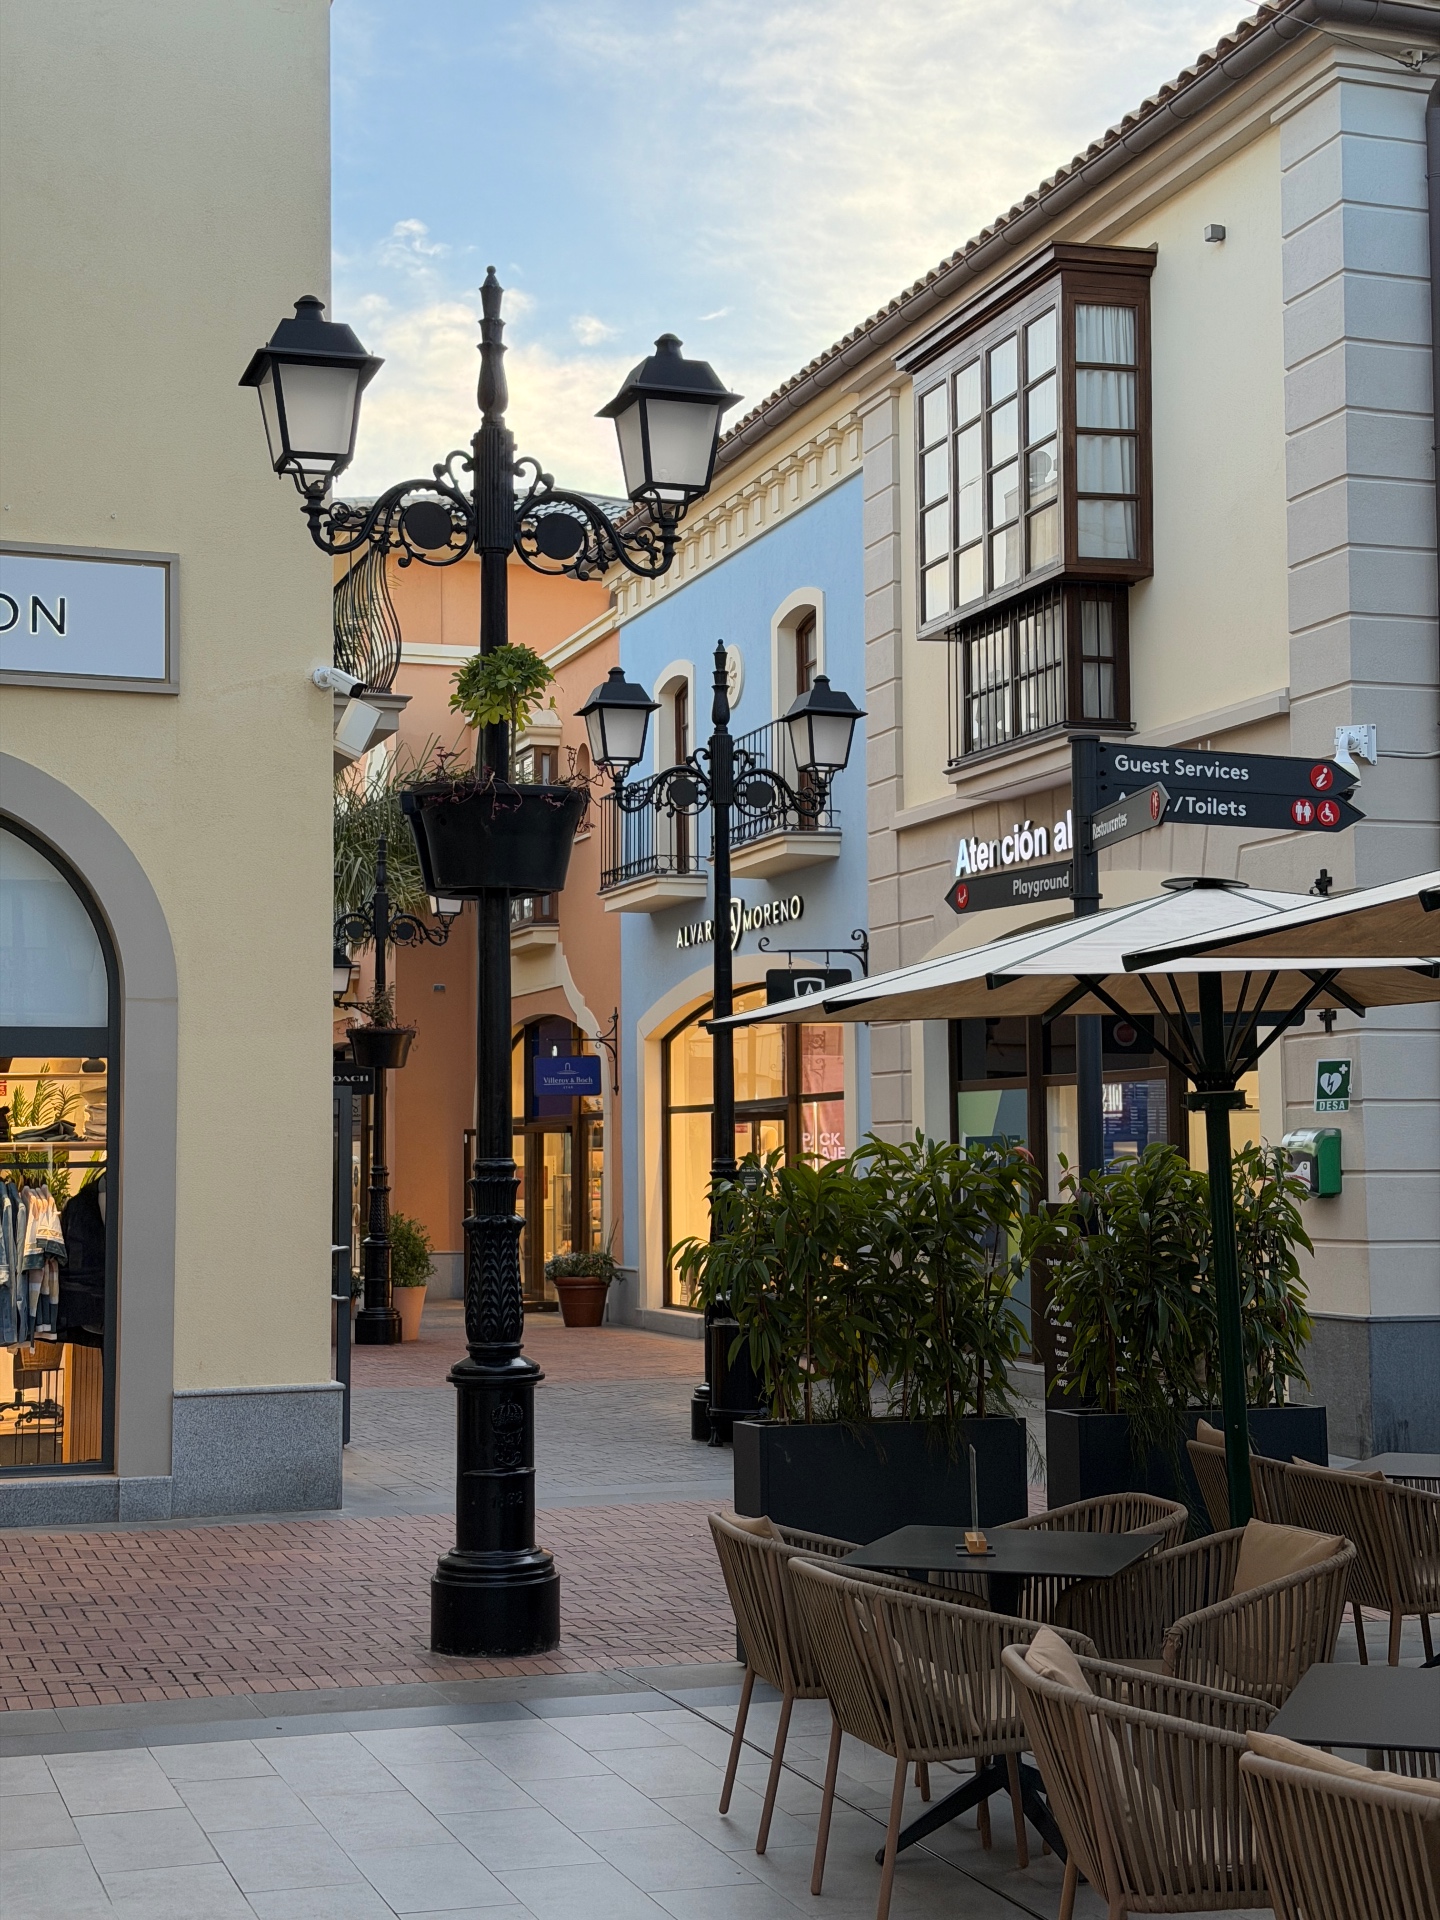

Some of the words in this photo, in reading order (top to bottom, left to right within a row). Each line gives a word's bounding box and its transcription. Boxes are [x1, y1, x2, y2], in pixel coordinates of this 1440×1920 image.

[1114, 754, 1170, 775] Guest
[1174, 758, 1249, 781] Services
[1092, 813, 1128, 841] Restaurantes
[955, 820, 1048, 877] Atención
[1053, 809, 1073, 852] al
[1012, 870, 1070, 898] Playground
[676, 919, 715, 949] ALVAR
[742, 895, 802, 932] MORENO
[543, 1076, 569, 1085] Villeroy
[576, 1076, 593, 1084] Boch
[1319, 1100, 1346, 1111] DESA
